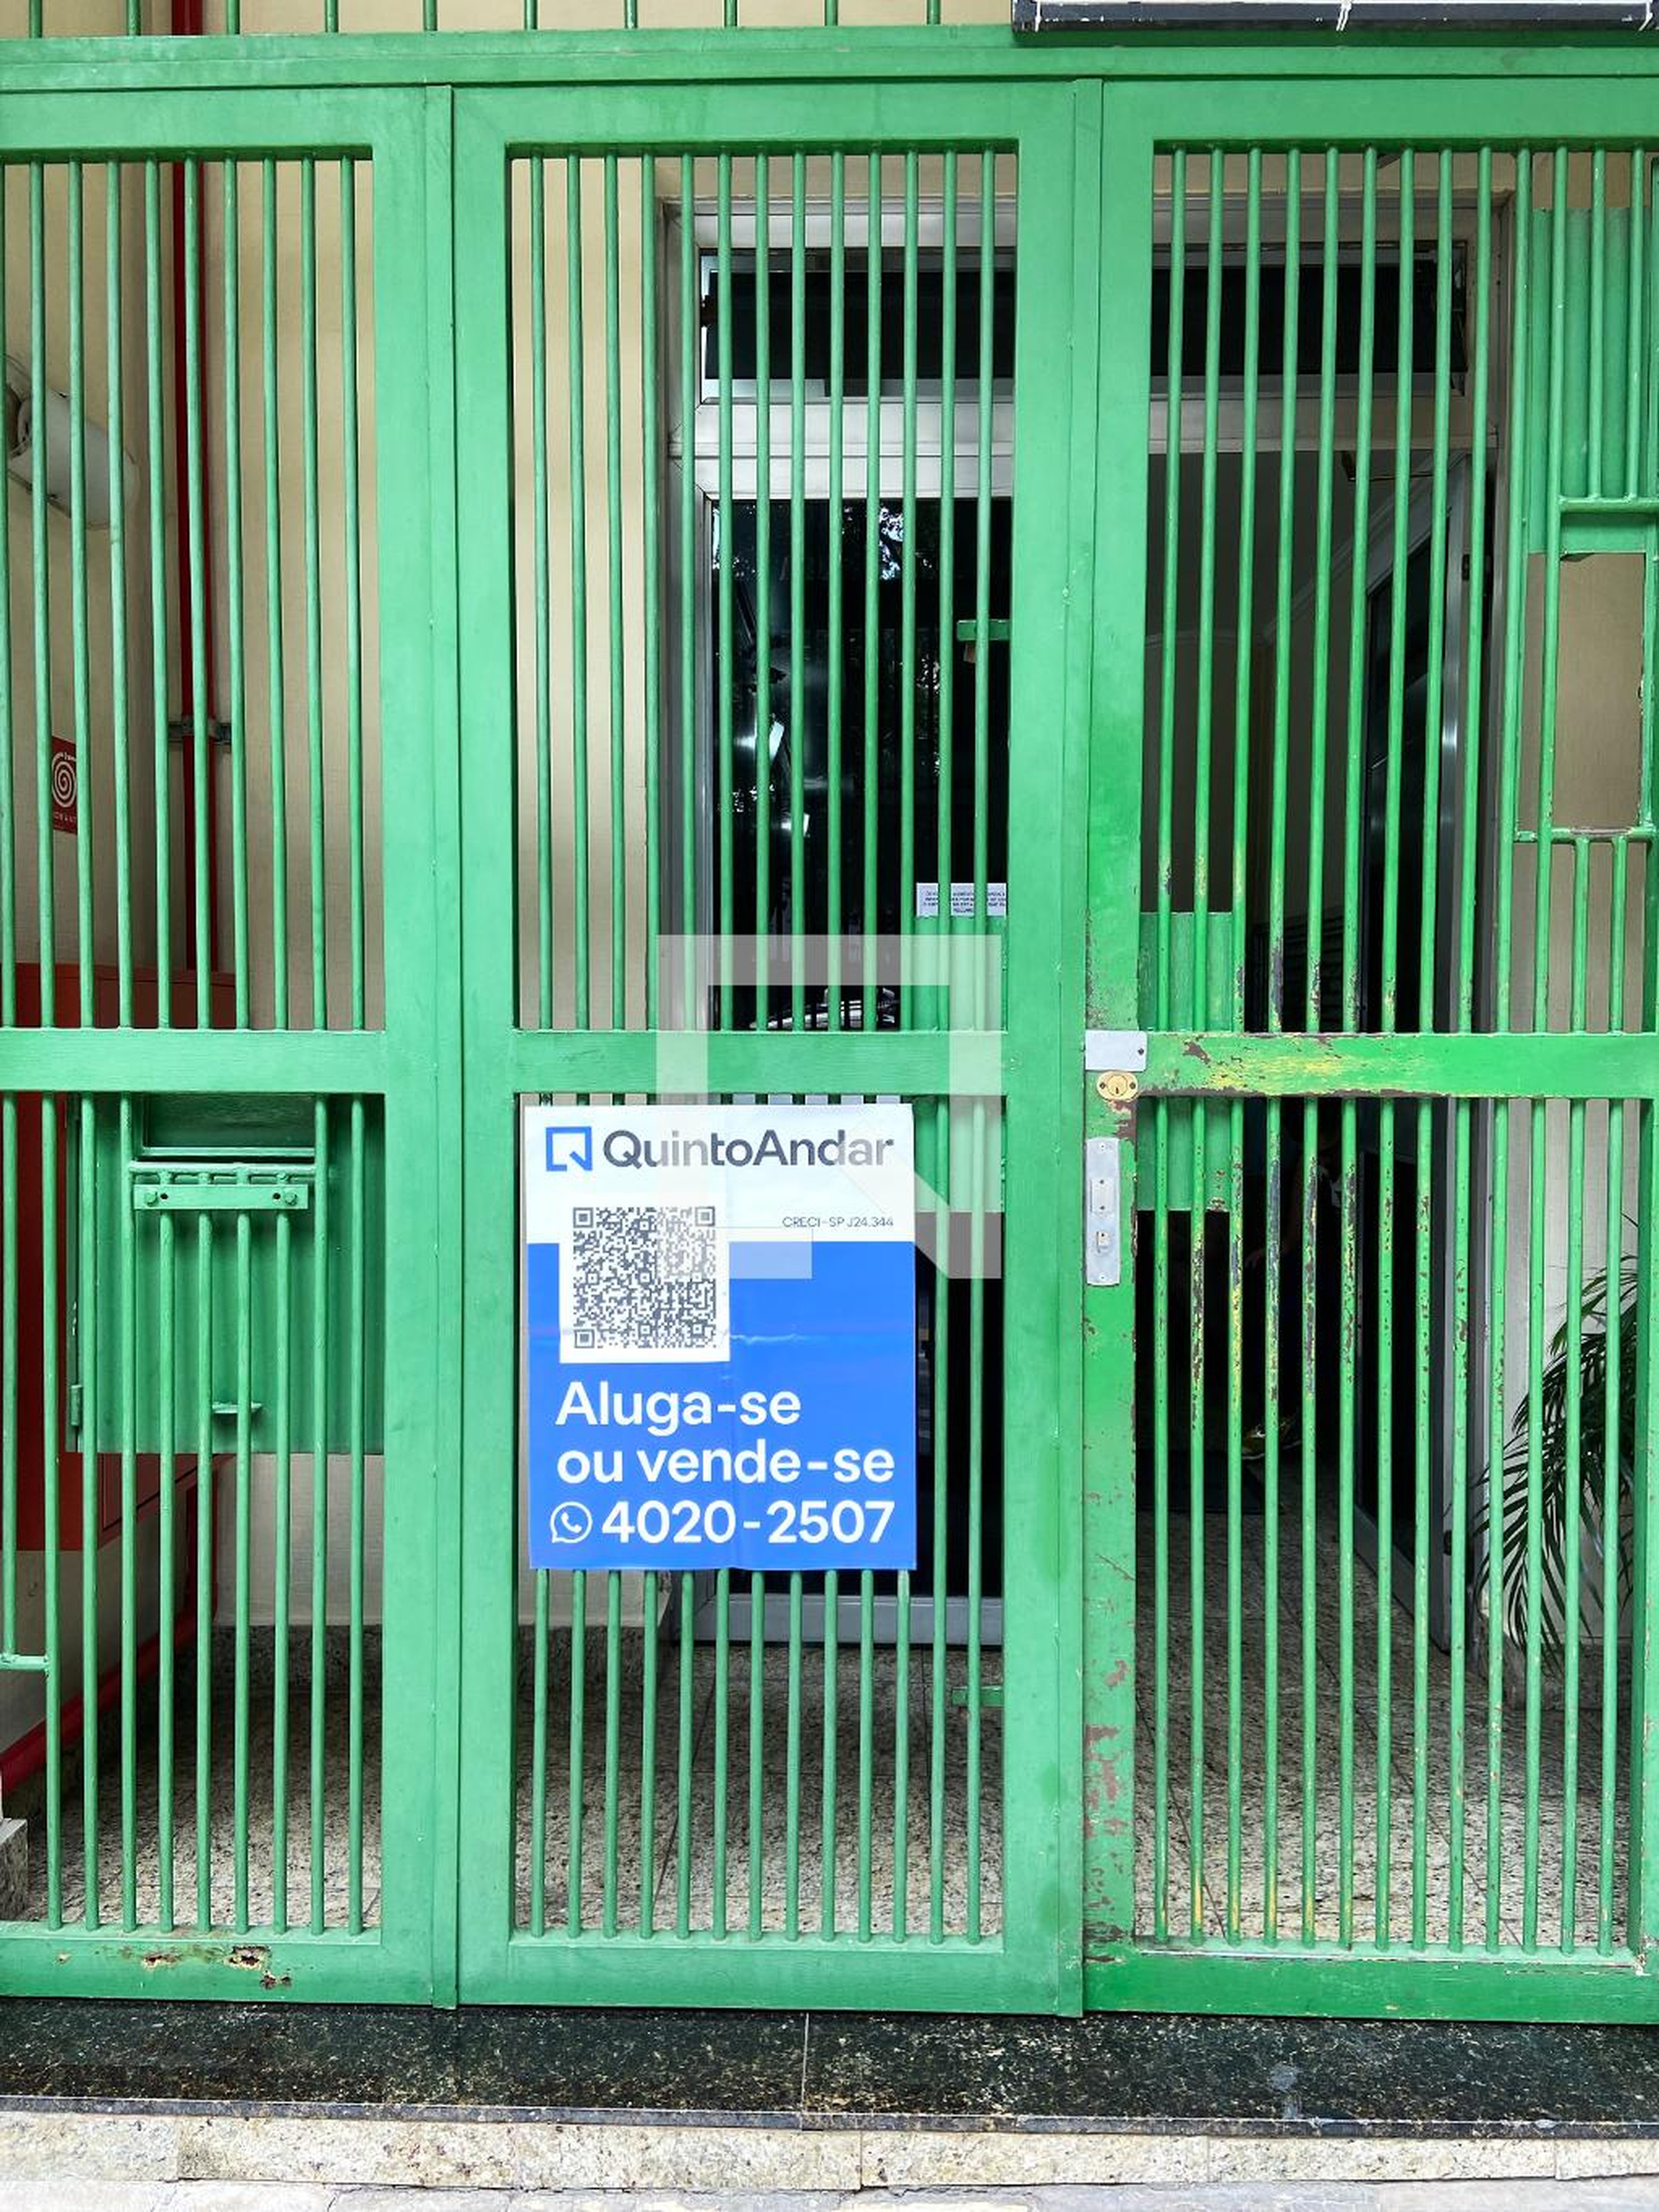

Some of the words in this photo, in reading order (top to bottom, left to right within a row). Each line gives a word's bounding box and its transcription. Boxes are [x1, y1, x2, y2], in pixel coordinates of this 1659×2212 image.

[603, 1129, 894, 1170] QuintoAndar
[847, 1216, 894, 1228] J24.344
[556, 1381, 801, 1436] Aluga-se
[557, 1451, 623, 1484] ou
[636, 1439, 894, 1483] vende-se
[601, 1500, 895, 1544] 4020-2507
